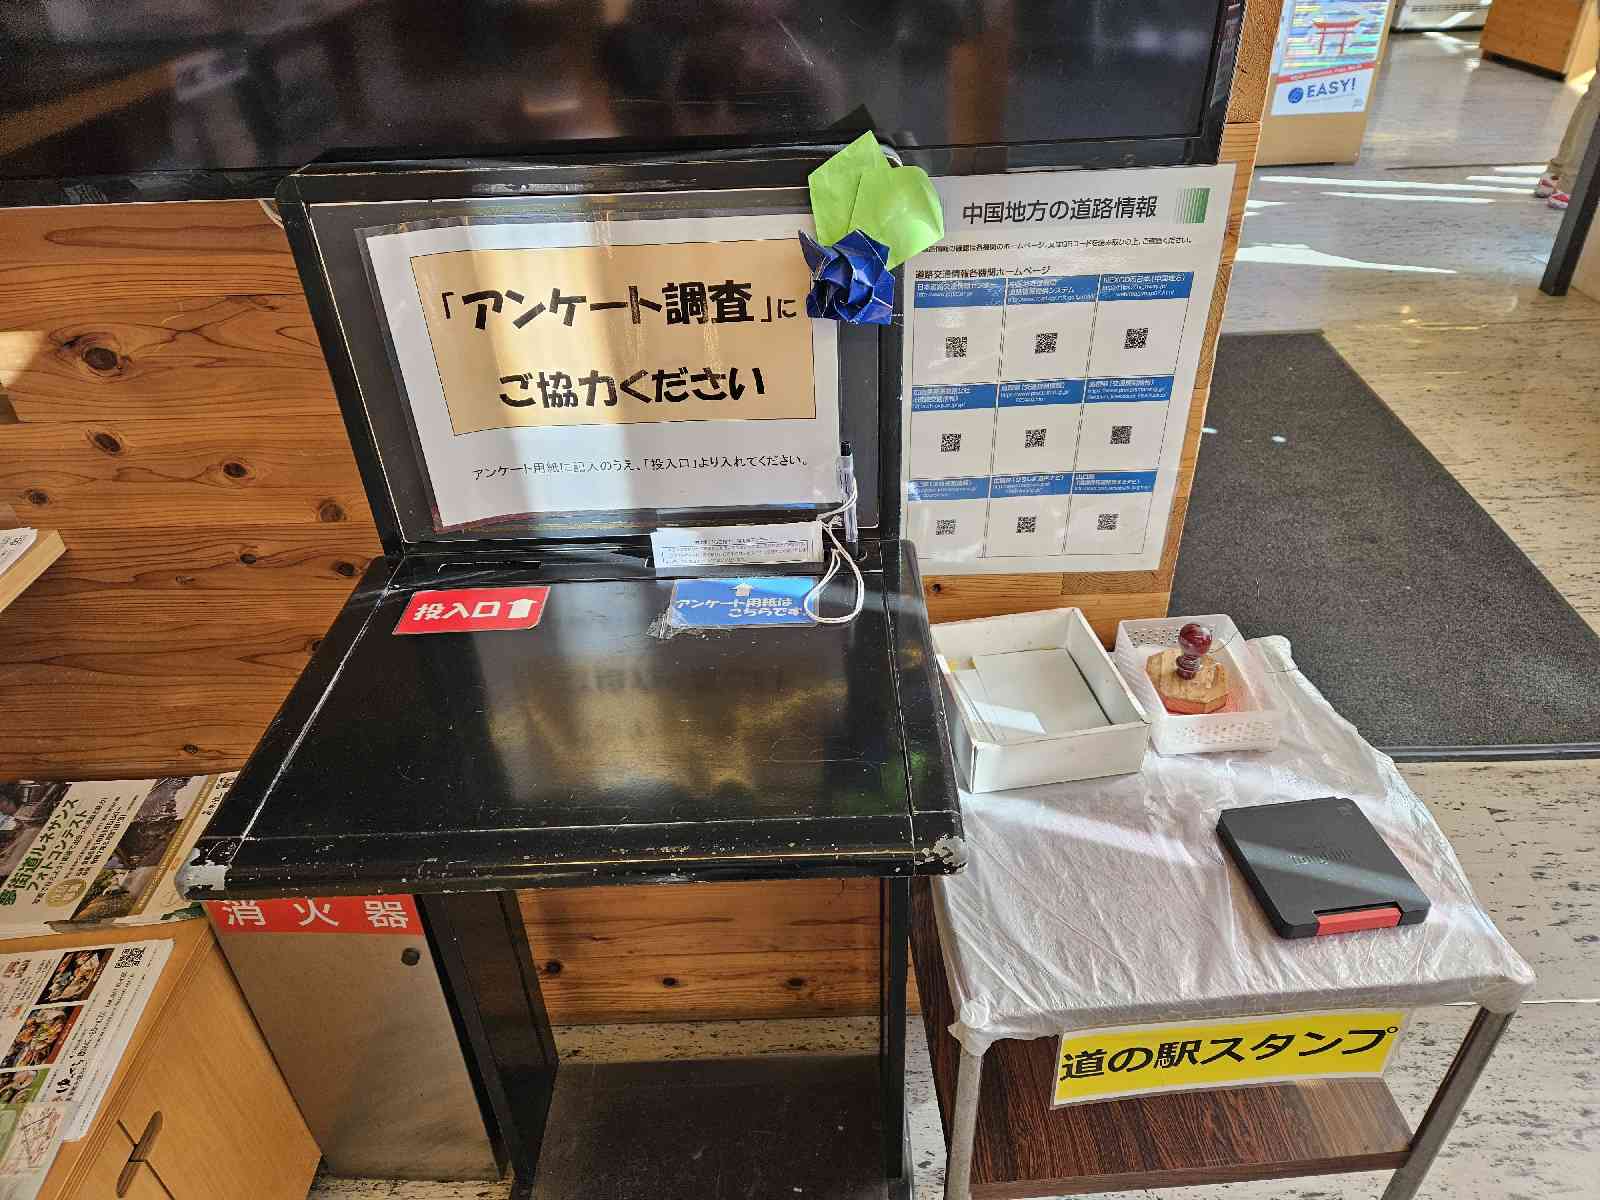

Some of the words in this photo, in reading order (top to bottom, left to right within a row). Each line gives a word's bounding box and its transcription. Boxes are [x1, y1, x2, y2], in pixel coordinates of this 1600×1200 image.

[1306, 77, 1356, 98] EASY!
[962, 195, 1158, 225] 中国地方の道路情報
[440, 279, 798, 330] 「アンケート調査」に
[499, 366, 766, 409] ご協力ください
[412, 601, 501, 622] 投入口
[222, 899, 409, 929] 消火器
[1060, 1026, 1399, 1081] 道の駅スタンプ
